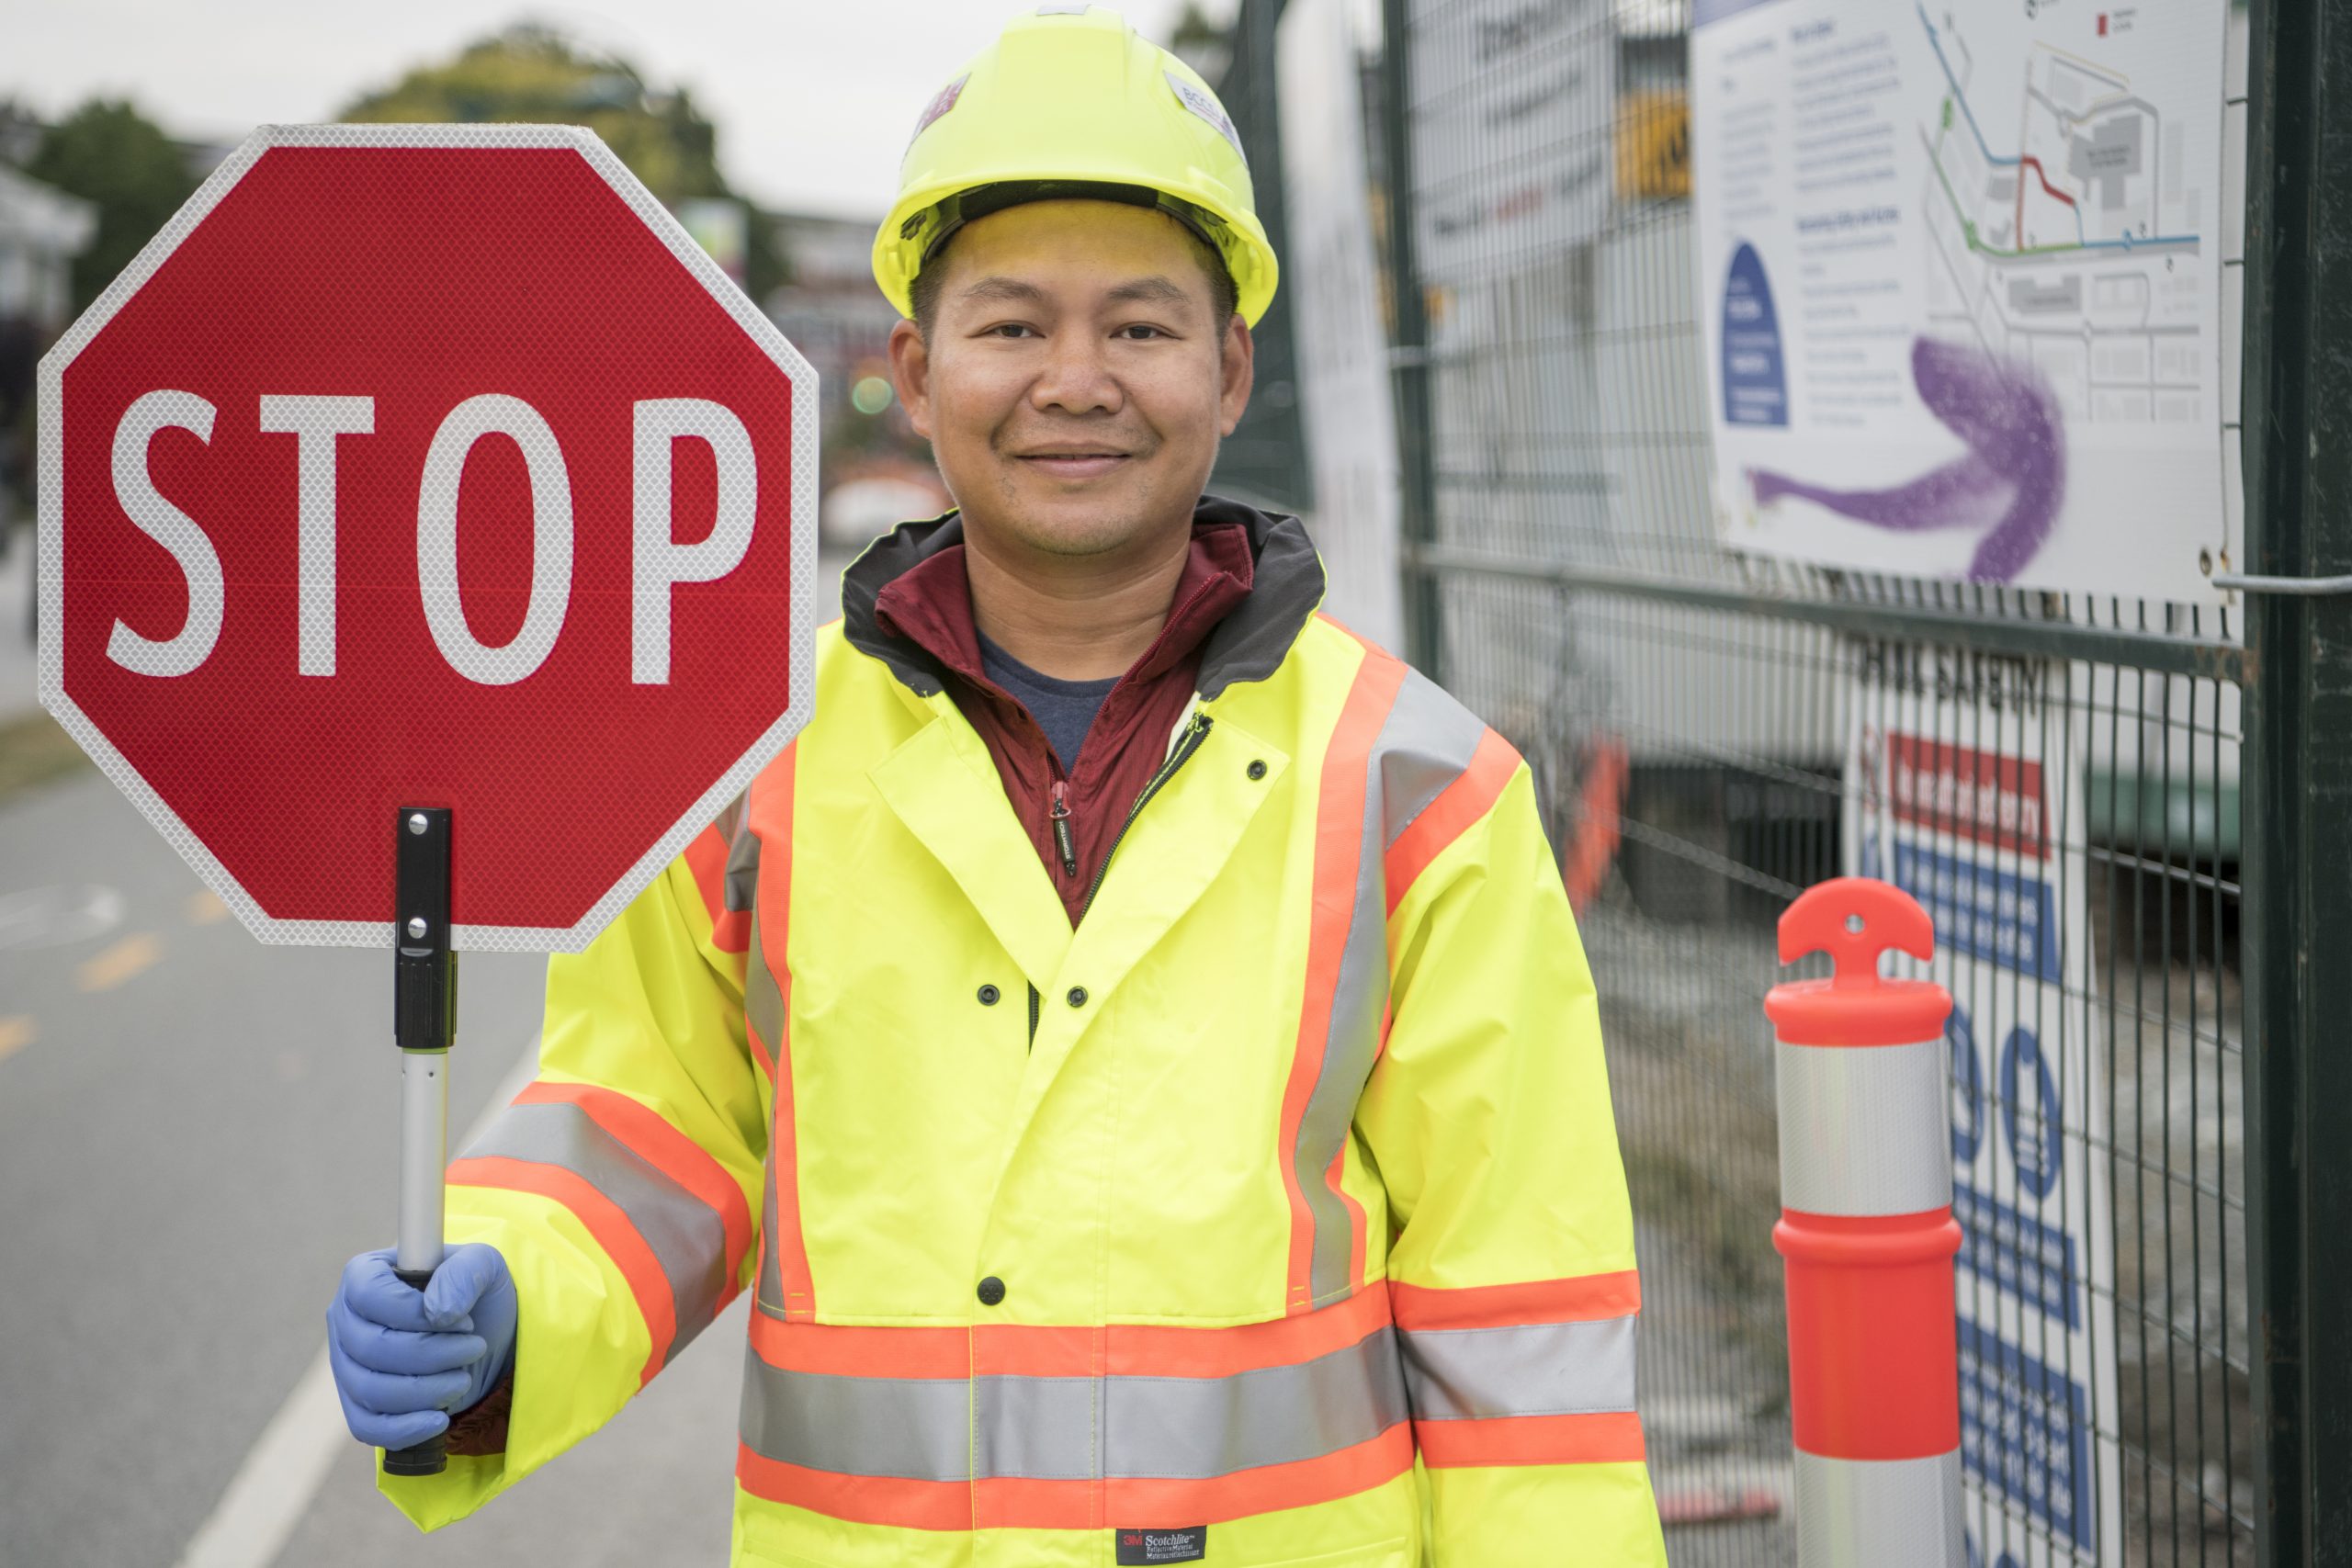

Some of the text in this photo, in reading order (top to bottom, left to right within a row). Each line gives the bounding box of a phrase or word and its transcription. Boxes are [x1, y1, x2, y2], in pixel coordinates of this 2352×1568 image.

[106, 388, 759, 686] STOP
[1059, 821, 1071, 859] STORMTECH
[1124, 1534, 1143, 1546] 3M
